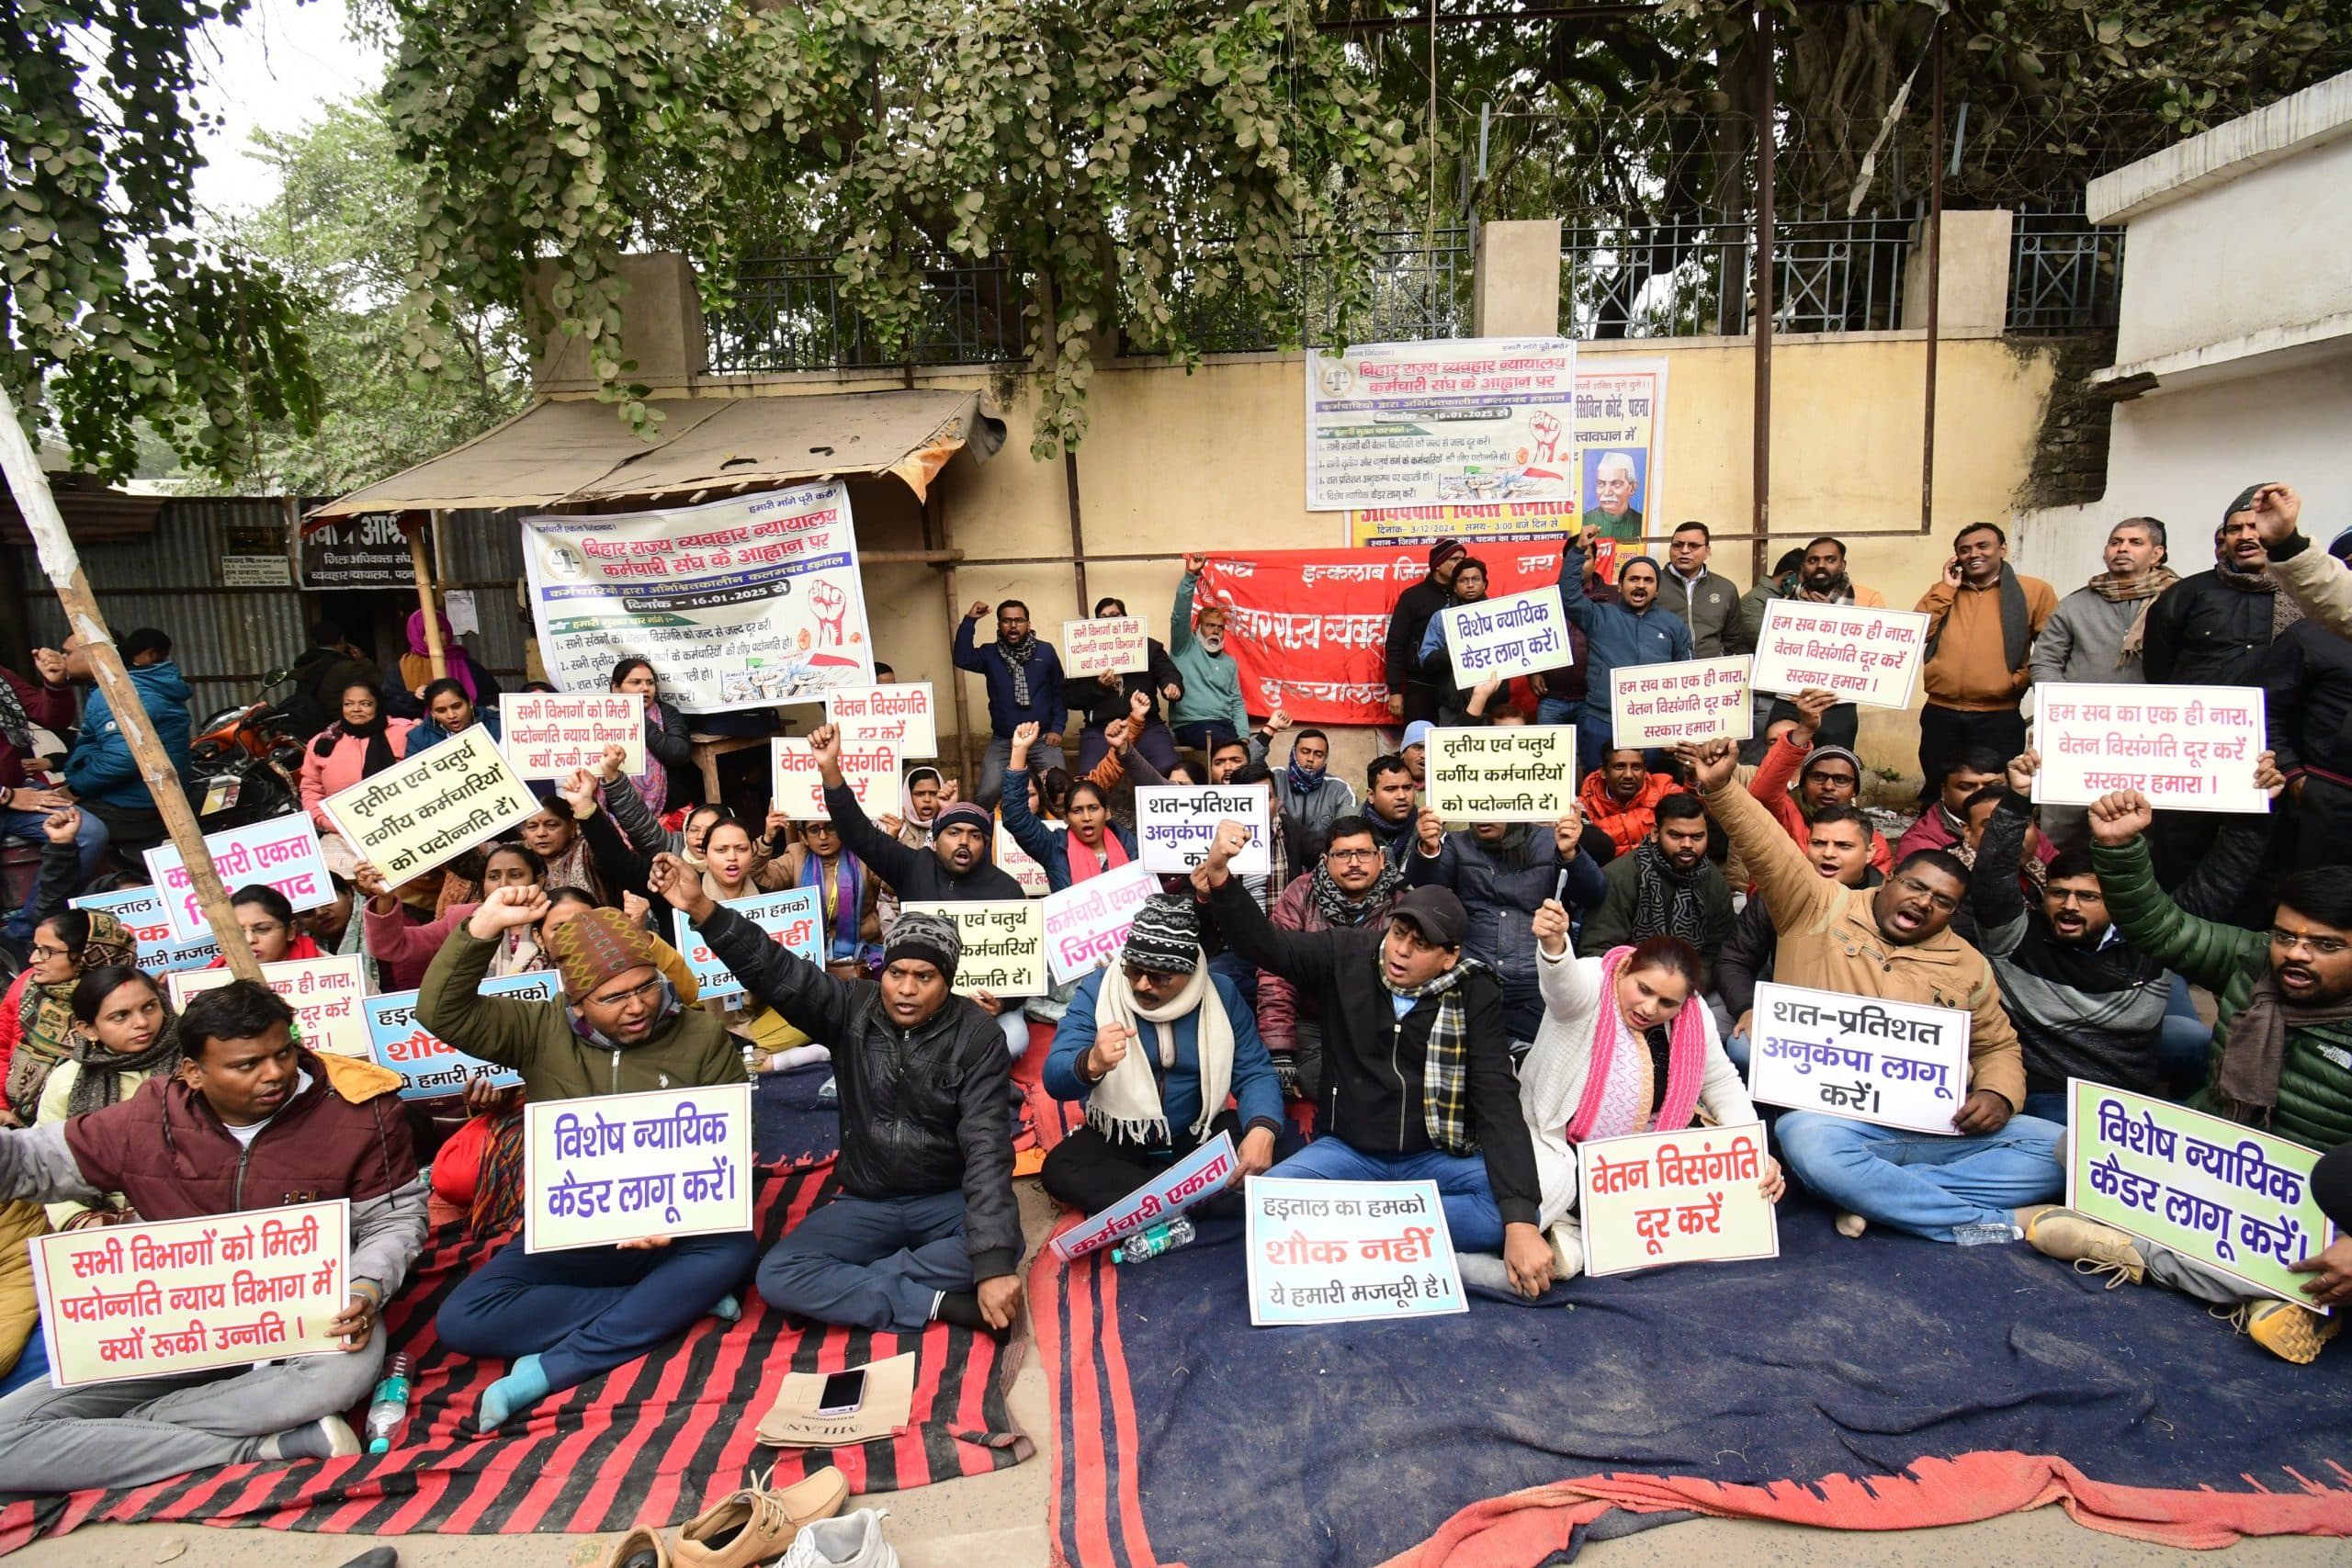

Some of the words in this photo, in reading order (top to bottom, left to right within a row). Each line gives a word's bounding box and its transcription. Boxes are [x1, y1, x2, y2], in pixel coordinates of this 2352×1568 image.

[1403, 362, 1438, 373] राज्य
[1499, 358, 1566, 369] न्यायालय
[1368, 376, 1427, 393] कर्मचारी
[1431, 376, 1456, 391] संघ
[1461, 376, 1476, 389] के
[1536, 376, 1556, 386] पर
[1576, 395, 1601, 419] सिविल
[1629, 398, 1649, 417] पटना
[1625, 427, 1636, 441] में
[582, 537, 626, 558] बिहार
[630, 538, 673, 556] राज्य
[676, 526, 750, 548] व्यवहार
[752, 509, 838, 536] न्यायालय
[602, 557, 667, 577] कर्मचारी
[671, 554, 704, 572] संघ
[710, 547, 731, 567] के
[808, 533, 830, 549] पर
[1518, 555, 1555, 574] जय
[692, 587, 767, 606] 16.01.2025
[772, 581, 787, 593] से
[1074, 625, 1086, 638] सभी
[1089, 623, 1111, 636] विभागों
[1113, 623, 1121, 634] को
[1123, 621, 1138, 634] मिली
[1456, 612, 1492, 639] विशेष
[1496, 600, 1549, 630] न्यायिक
[1772, 615, 1791, 631] हम
[1819, 620, 1836, 634] का
[1841, 623, 1862, 637] एक
[1867, 619, 1881, 640] ही
[1885, 626, 1916, 645] नारा,
[1071, 640, 1097, 654] पदोन्नति
[1099, 642, 1114, 651] न्याय
[1116, 637, 1135, 650] विभाग
[1461, 645, 1491, 670] कैडर
[1495, 640, 1531, 667] लागू
[1528, 627, 1559, 655] करें।
[1774, 639, 1803, 658] वेतन
[1806, 638, 1857, 663] विसंगति
[1860, 650, 1877, 671] दूर
[1881, 650, 1907, 670] करें
[1080, 657, 1092, 669] क्यों
[1787, 668, 1827, 686] सरकार
[1830, 673, 1867, 690] हमारा
[517, 700, 541, 720] सभी
[545, 699, 585, 719] विभागों
[587, 700, 602, 718] को
[605, 699, 630, 718] मिली
[833, 694, 866, 716] वेतन
[870, 691, 926, 715] विसंगति
[1627, 701, 1652, 716] वेतन
[1656, 696, 1701, 715] विसंगति
[1704, 696, 1718, 716] दूर
[1722, 689, 1742, 707] करें
[512, 724, 560, 744] पदोन्नति
[563, 728, 590, 742] न्याय
[594, 723, 625, 742] विभाग
[628, 724, 639, 741] में
[1645, 724, 1682, 738] सरकार
[1685, 719, 1715, 735] हमारा
[529, 749, 551, 767] क्यों
[1443, 735, 1485, 758] तृतीय
[1490, 734, 1514, 752] एवं
[1518, 733, 1556, 757] चतुर्थ
[2059, 731, 2099, 754] वेतन
[2107, 731, 2177, 758] विसंगति
[2184, 740, 2209, 768] दूर
[2213, 737, 2248, 761] करें
[349, 786, 402, 818] तृतीय
[402, 761, 432, 789] एवं
[432, 739, 477, 773] चतुर्थ
[1436, 764, 1479, 782] वर्गीय
[1484, 762, 1566, 782] कर्मचारियों
[2084, 772, 2147, 792] सरकार
[2151, 774, 2202, 794] हमारा
[362, 814, 415, 848] वर्गीय
[415, 762, 504, 819] कर्मचारियों
[1148, 791, 1253, 816] शत-प्रतिशत
[1442, 795, 1463, 811] को
[1468, 794, 1533, 811] पदोन्नति
[1539, 794, 1557, 810] दें।
[389, 849, 420, 874] को
[418, 808, 495, 856] पदोन्नति
[493, 796, 519, 817] दें।
[1145, 819, 1214, 849] अनुकंपा
[1046, 887, 1107, 935] कर्मचारी
[1108, 876, 1155, 910] एकता
[1772, 999, 1944, 1046] शत-प्रतिशत
[1762, 1035, 1872, 1075] अनुकंपा
[1881, 1054, 1954, 1100] लागू
[1819, 1080, 1880, 1113] करें।
[554, 1111, 626, 1160] विशेष
[633, 1101, 729, 1149] न्यायिक
[1591, 1154, 1649, 1195] वेतन
[1656, 1134, 1759, 1189] विसंगति
[2098, 1099, 2178, 1162] विशेष
[2185, 1141, 2304, 1206] न्यायिक
[548, 1169, 614, 1218] कैडर
[618, 1174, 682, 1224] लागू
[683, 1156, 735, 1202] करें।
[1070, 1194, 1161, 1257] कर्मचारी
[1165, 1153, 1230, 1206] एकता
[1262, 1195, 1329, 1223] हड़ताल
[1334, 1197, 1361, 1218] का
[1367, 1192, 1427, 1218] हमको
[1634, 1207, 1671, 1256] दूर
[1677, 1191, 1724, 1235] करें
[2089, 1152, 2160, 1213] कैडर
[2165, 1186, 2236, 1262] लागू
[2240, 1214, 2309, 1267] करें।
[70, 1236, 124, 1279] सभी
[130, 1228, 217, 1272] विभागों
[221, 1224, 254, 1262] को
[261, 1213, 319, 1257] मिली
[1266, 1229, 1349, 1267] शौक
[1358, 1225, 1436, 1264] नहीं
[60, 1280, 163, 1323] पदोन्नति
[169, 1283, 226, 1312] न्याय
[232, 1269, 306, 1307] विभाग
[312, 1258, 337, 1297] में
[1270, 1284, 1285, 1307] ये
[1291, 1280, 1346, 1308] हमारी
[1424, 1273, 1450, 1300] है।
[98, 1326, 146, 1363] क्यों
[215, 1311, 286, 1351] उन्नति
